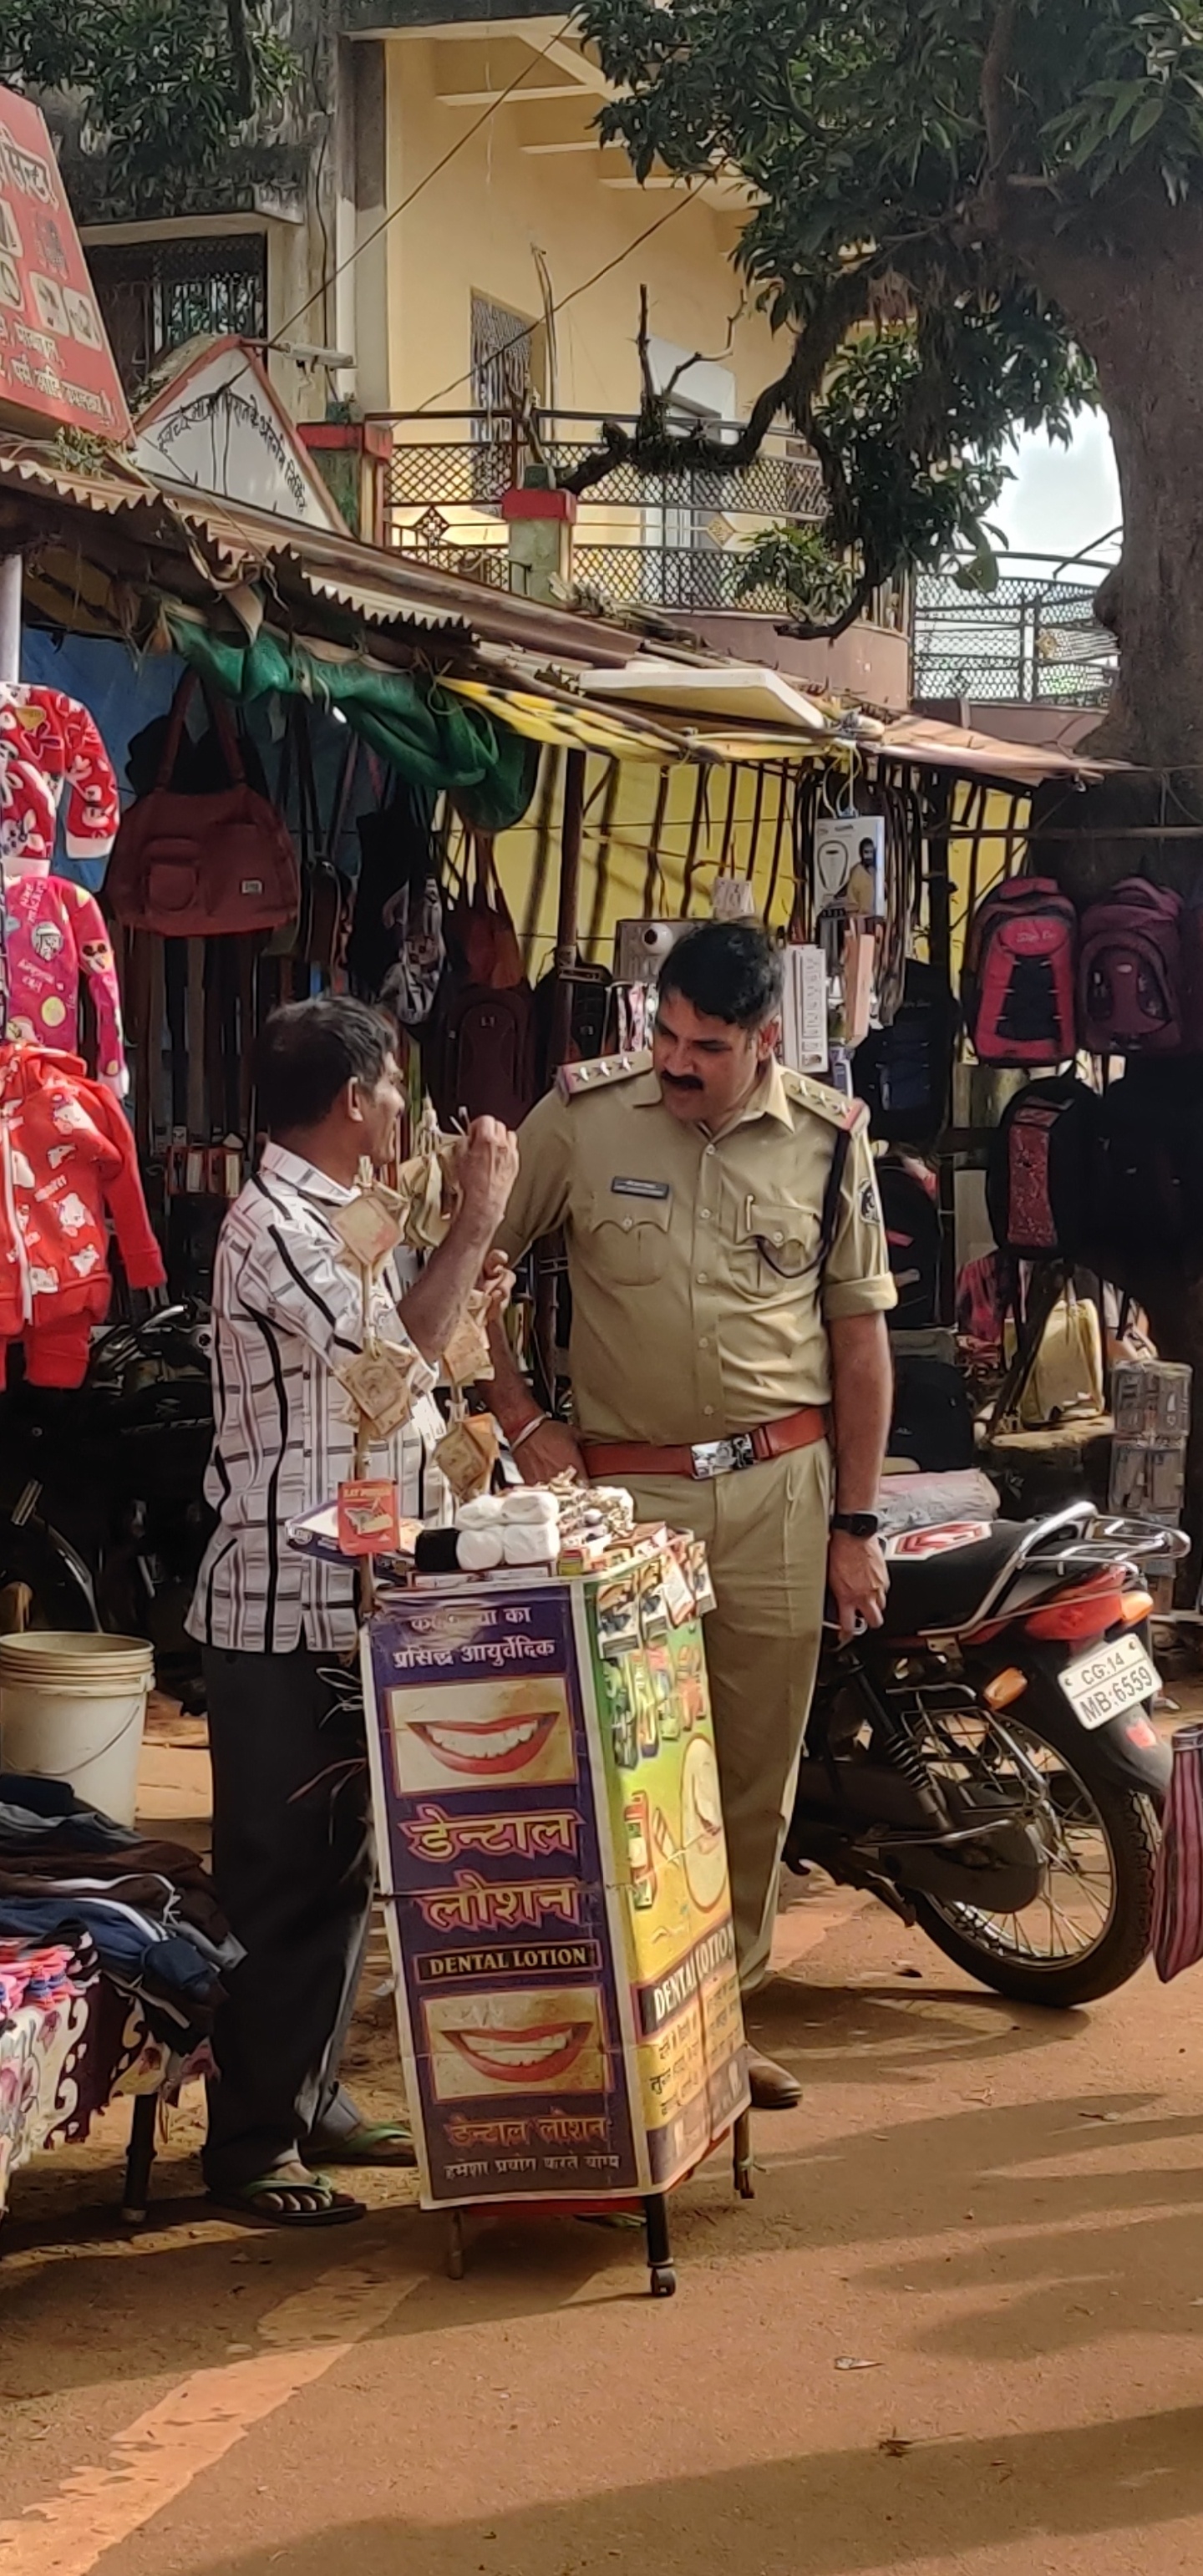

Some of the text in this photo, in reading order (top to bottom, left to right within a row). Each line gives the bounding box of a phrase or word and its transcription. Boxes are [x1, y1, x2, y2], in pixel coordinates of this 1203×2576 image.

[503, 1607, 531, 1623] का
[393, 1635, 555, 1668] प्रसिद्ध आयुर्वेदिक
[1080, 1666, 1153, 1722] MB:6559
[404, 1805, 581, 1860] डेन्टाल
[419, 1871, 578, 1929] लोशन
[429, 1947, 586, 1975] DENTAL LOTION
[444, 2158, 490, 2180] हमेशा
